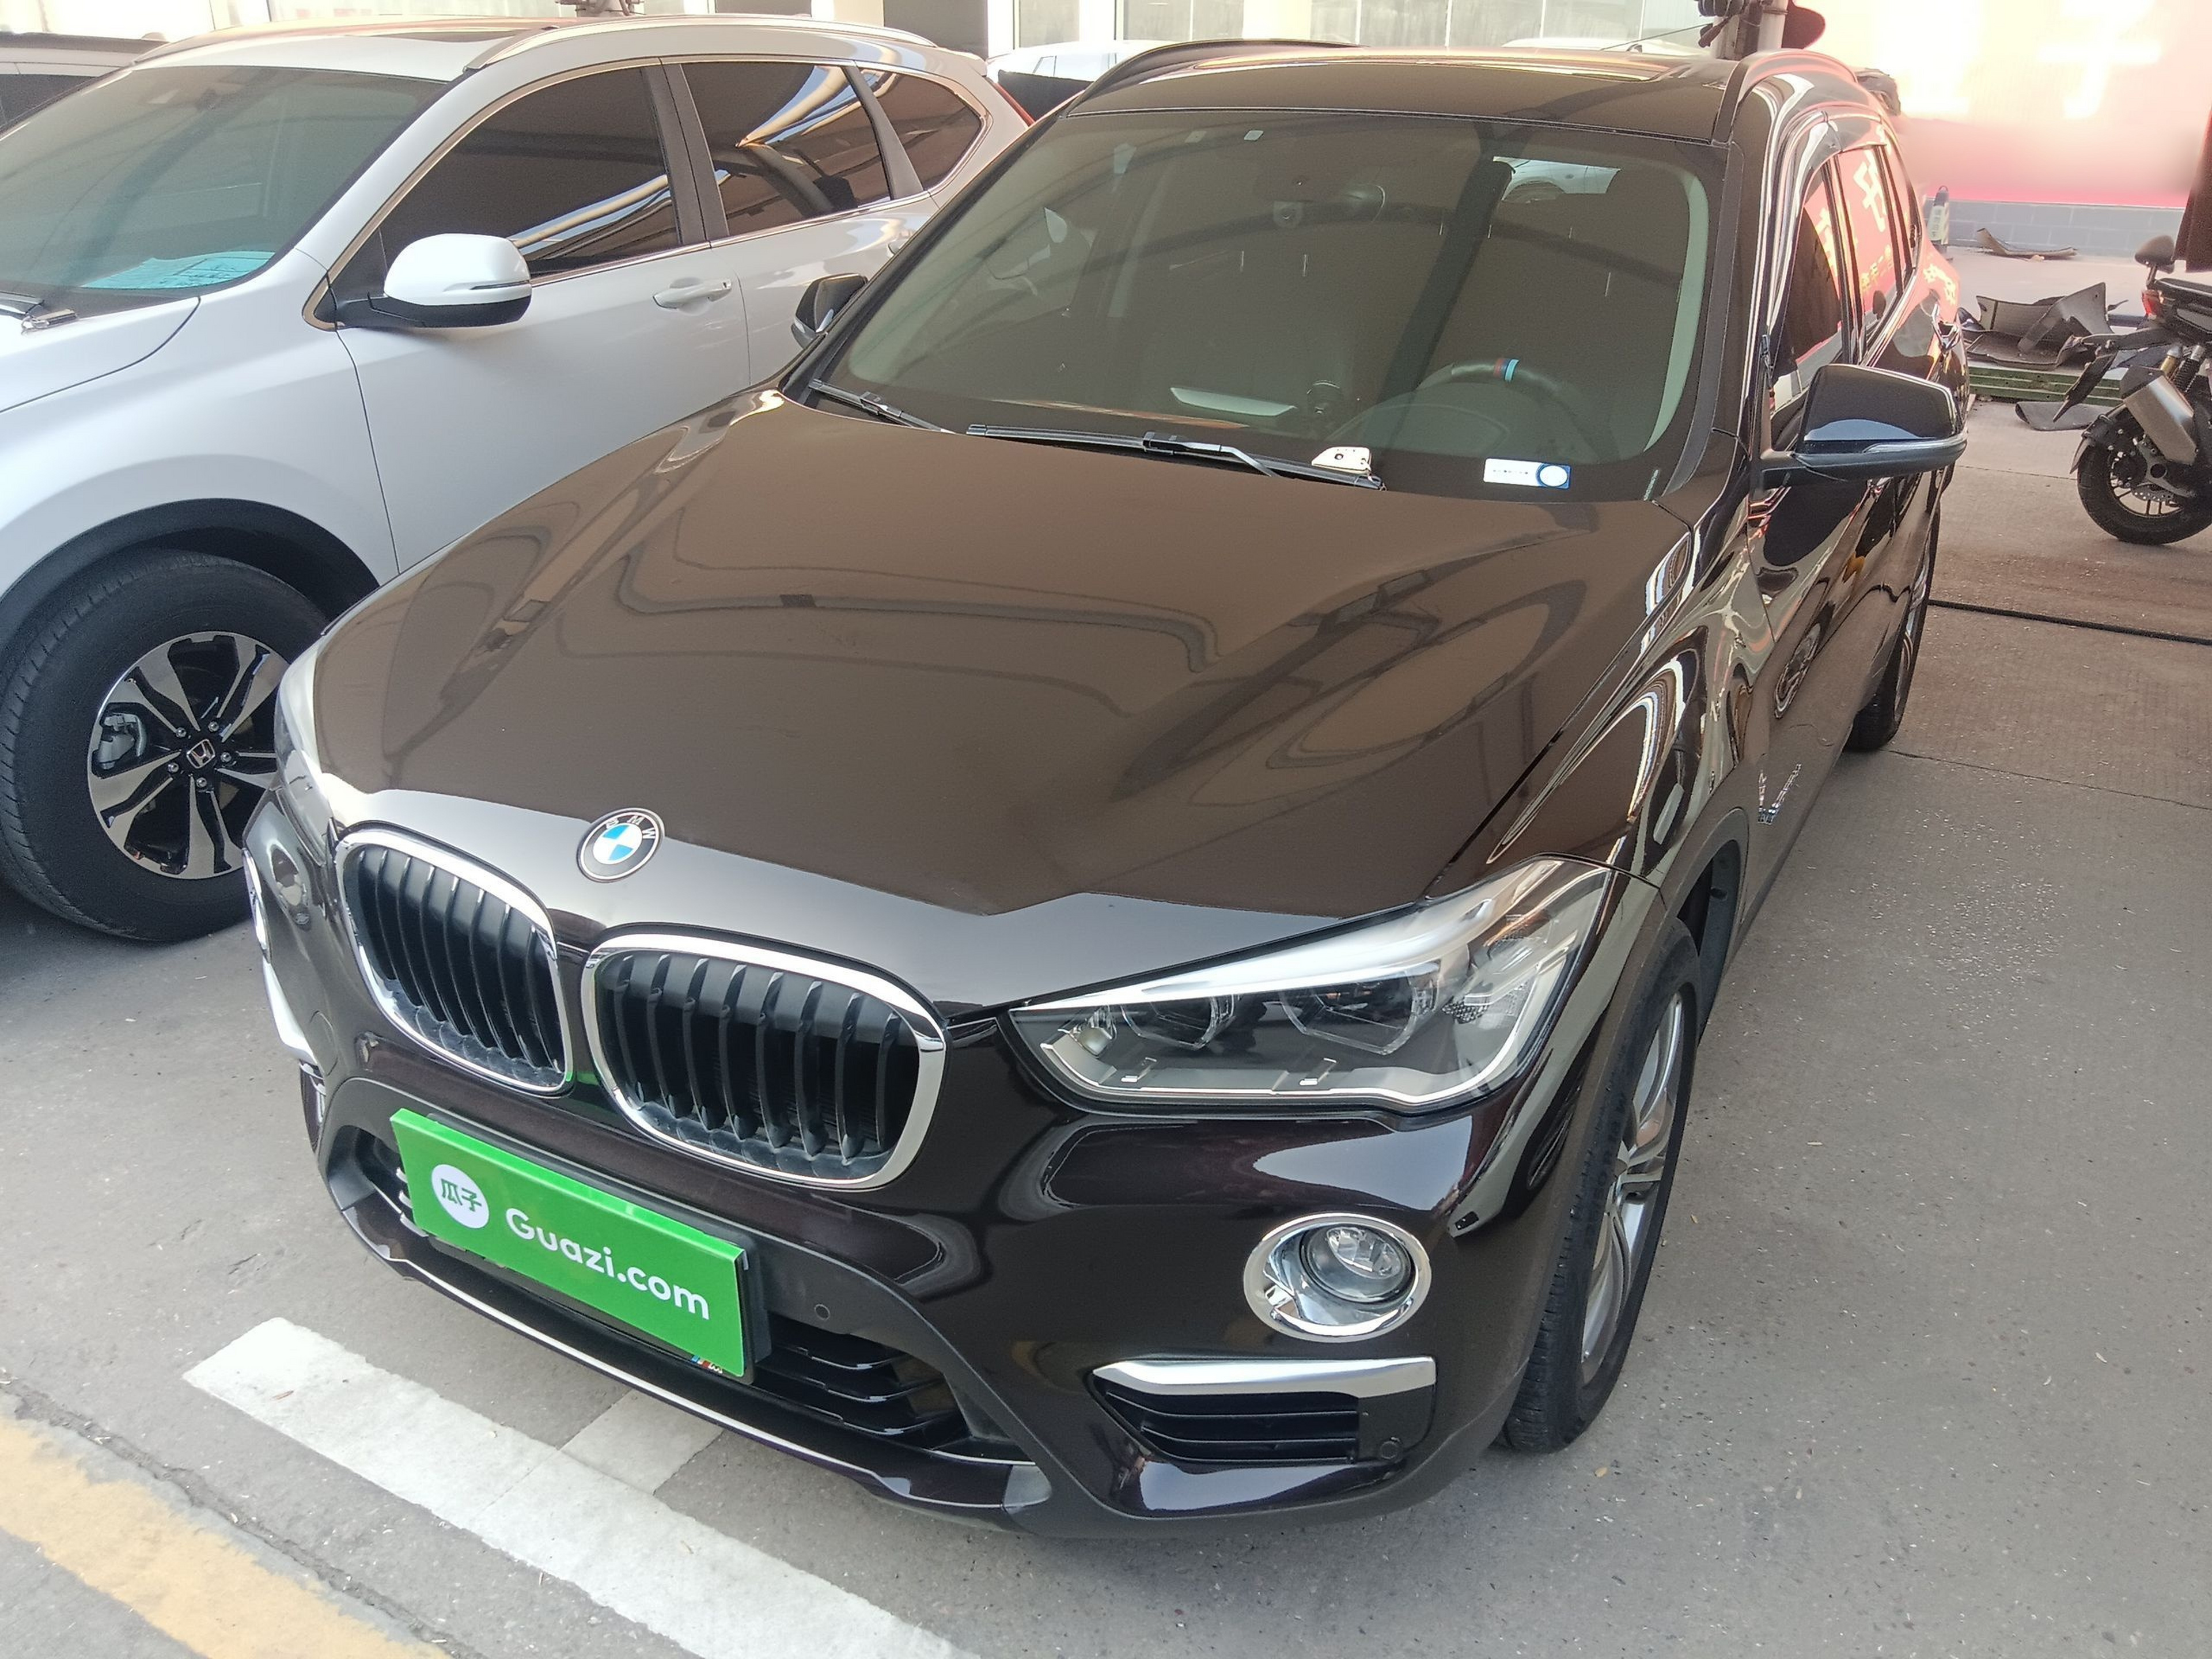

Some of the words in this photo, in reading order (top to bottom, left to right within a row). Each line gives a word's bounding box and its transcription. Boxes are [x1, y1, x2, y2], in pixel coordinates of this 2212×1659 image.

[605, 815, 656, 839] BMW
[440, 1177, 483, 1213] 瓜子
[505, 1207, 710, 1321] Guazi.com
